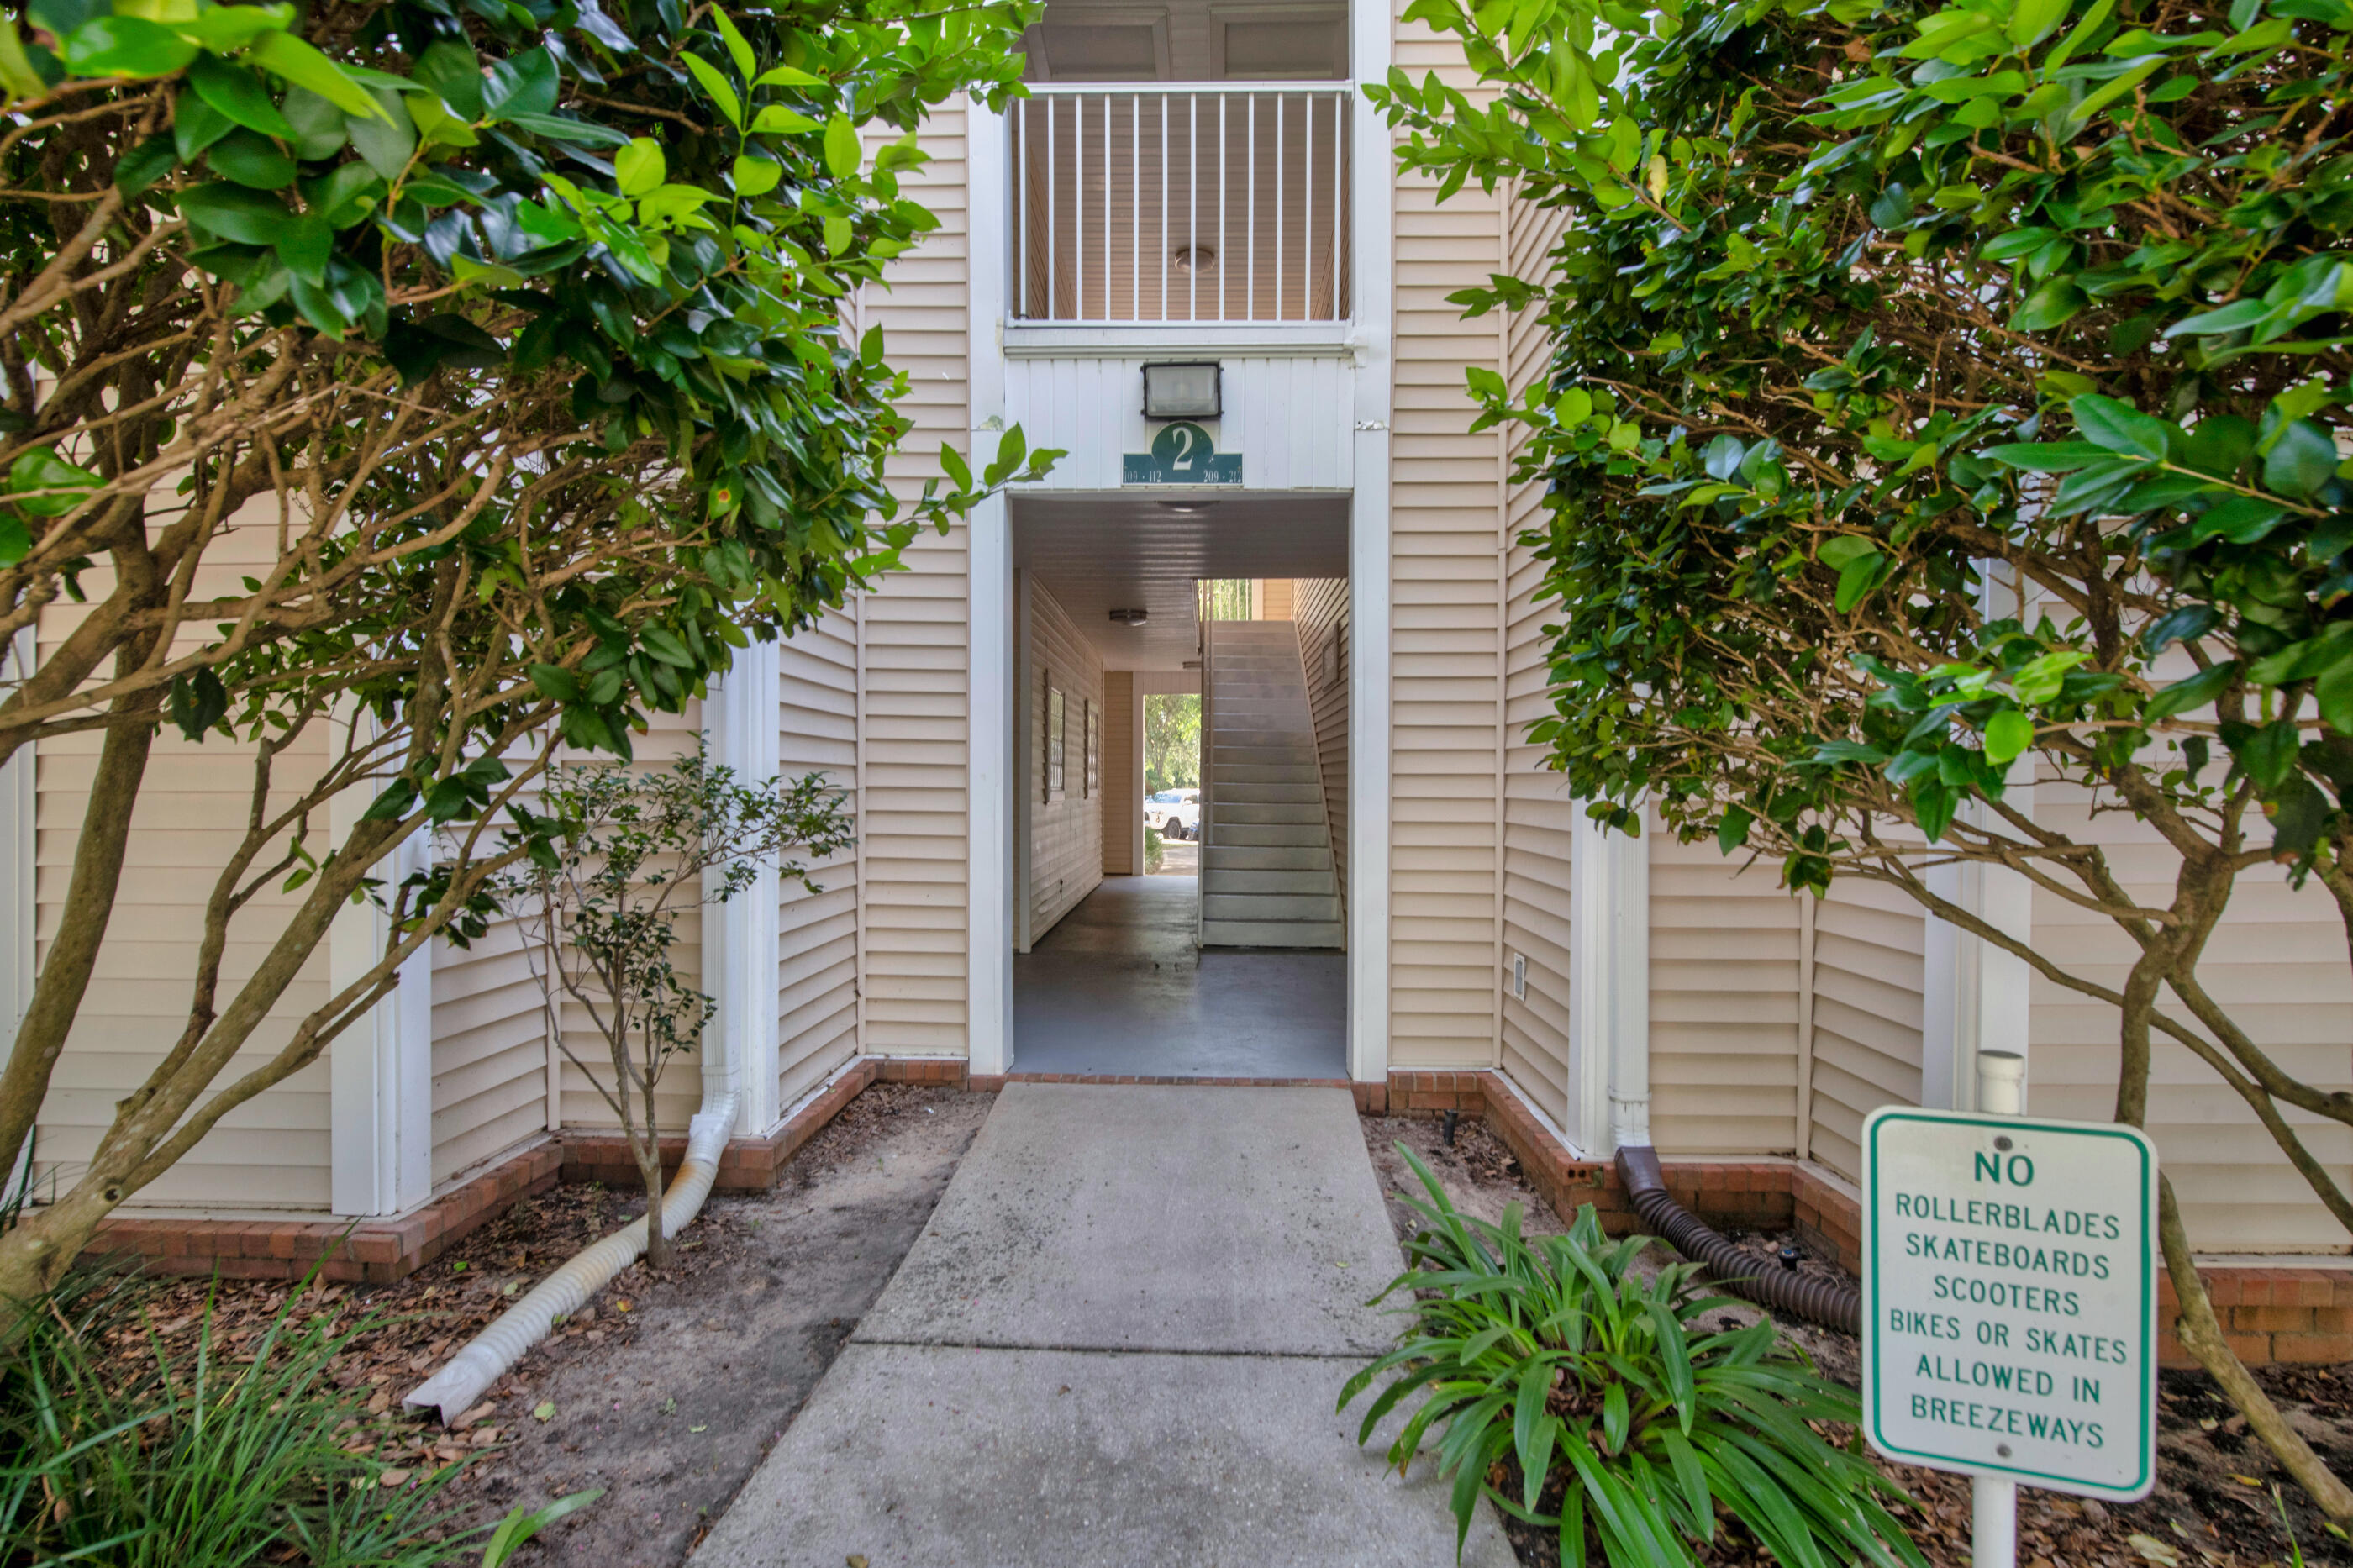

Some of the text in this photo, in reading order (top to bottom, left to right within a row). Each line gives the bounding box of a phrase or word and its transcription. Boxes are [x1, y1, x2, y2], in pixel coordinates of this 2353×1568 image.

[1172, 426, 1193, 471] 2
[1124, 470, 1161, 483] 109 112
[1203, 470, 1242, 483] 209 212
[1974, 1151, 2035, 1187] NO
[1895, 1192, 2121, 1240] ROLLERBLADES
[1905, 1232, 2111, 1281] SKATEBOARDS
[1933, 1275, 2081, 1317] SCOOTERS
[1890, 1308, 2129, 1365] BIKES OR SKATES
[1915, 1353, 2101, 1405] ALLOWED IN
[1911, 1393, 2105, 1450] BREEZEWAYS
